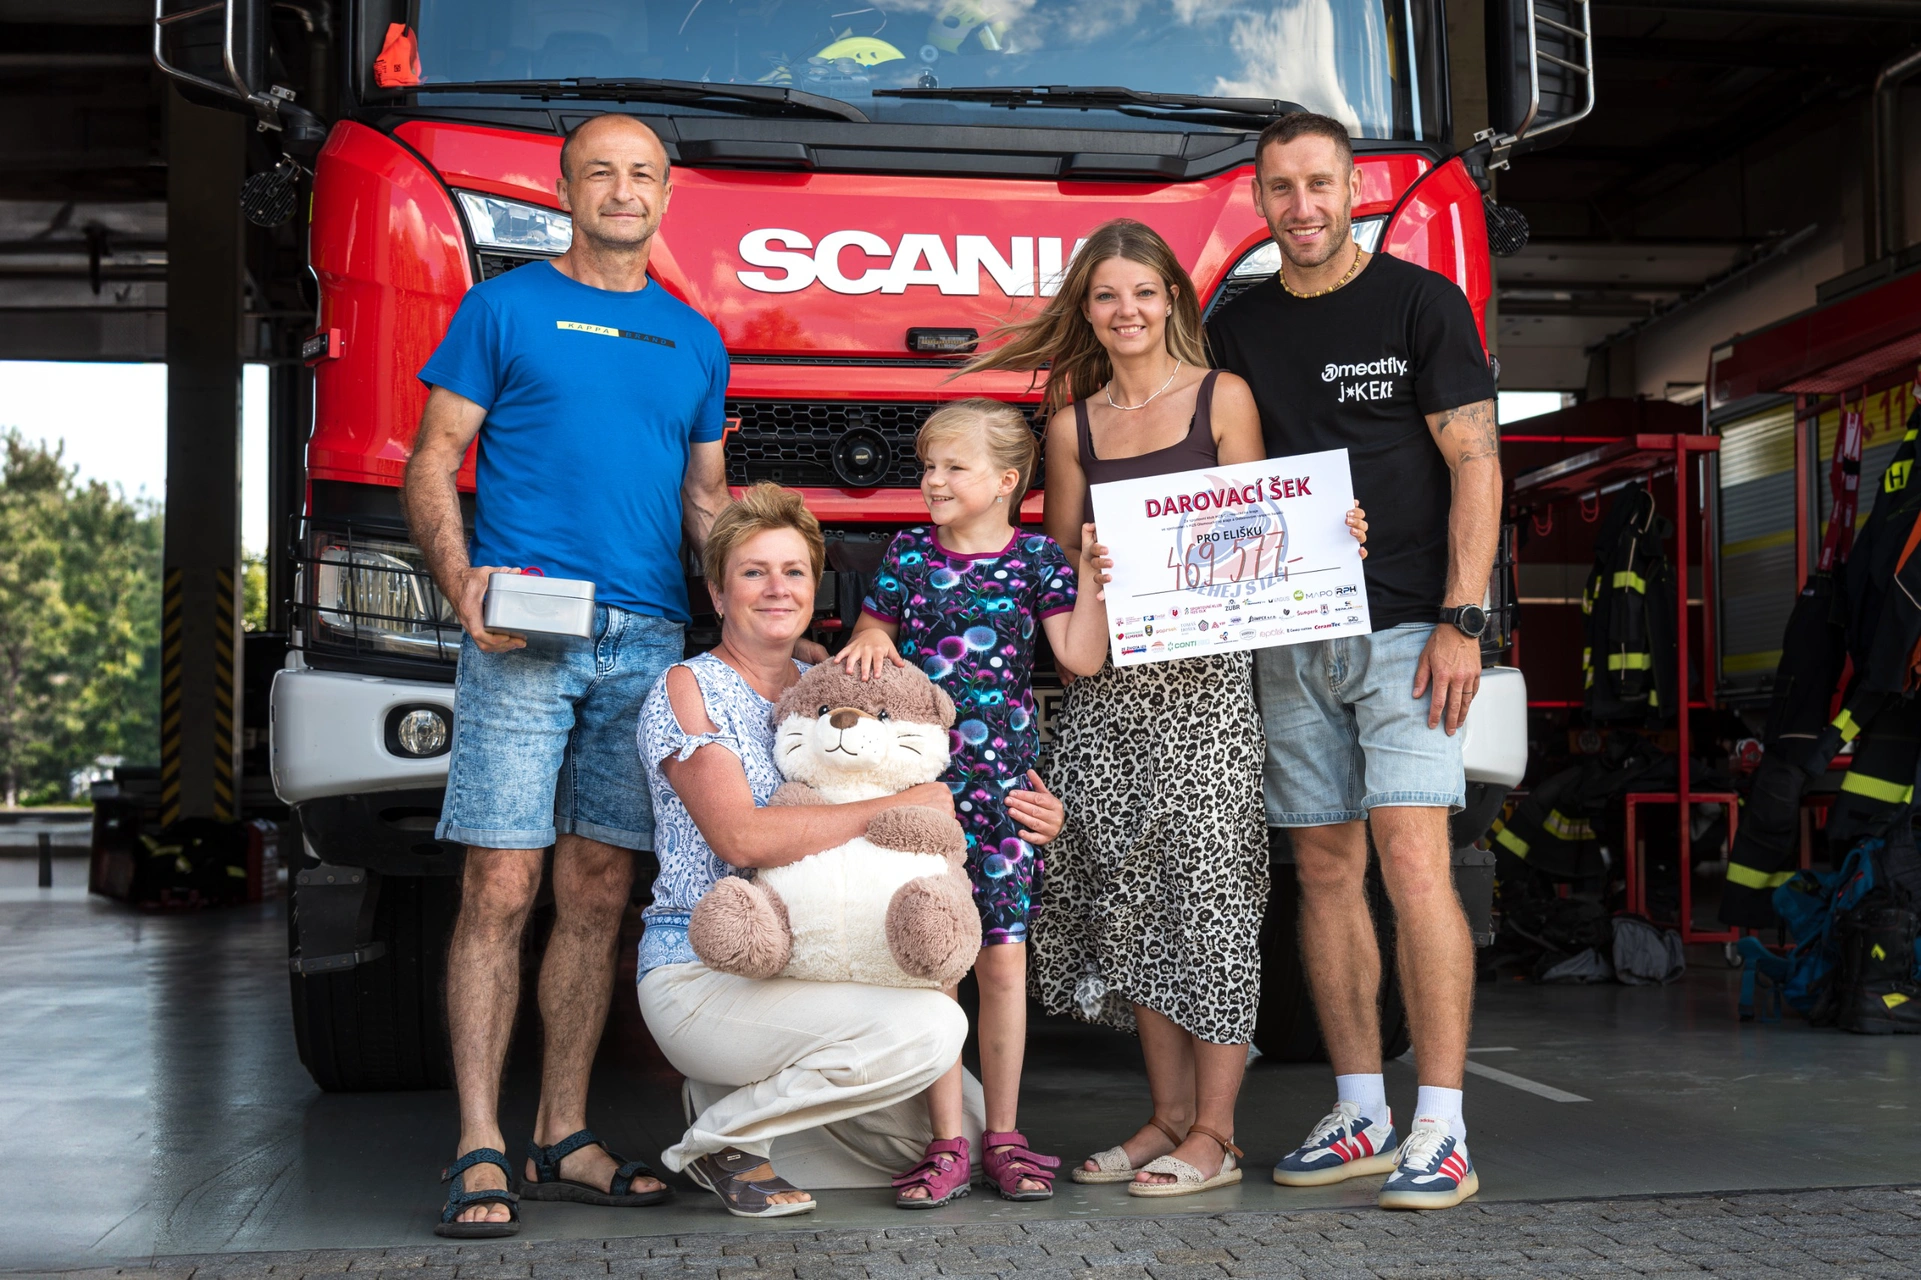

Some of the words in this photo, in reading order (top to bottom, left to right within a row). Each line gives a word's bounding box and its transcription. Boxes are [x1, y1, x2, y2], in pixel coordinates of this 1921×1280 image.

[737, 228, 1092, 297] SCANI
[567, 322, 610, 334] KAPPA
[1145, 478, 1264, 518] DAROVACÍ
[1268, 475, 1312, 500] ŠEK
[1196, 532, 1220, 544] PRO
[1223, 525, 1262, 541] ELIŠKU
[1305, 590, 1333, 599] MAPO
[1336, 585, 1356, 595] RPH
[1314, 622, 1341, 630] CeramTec
